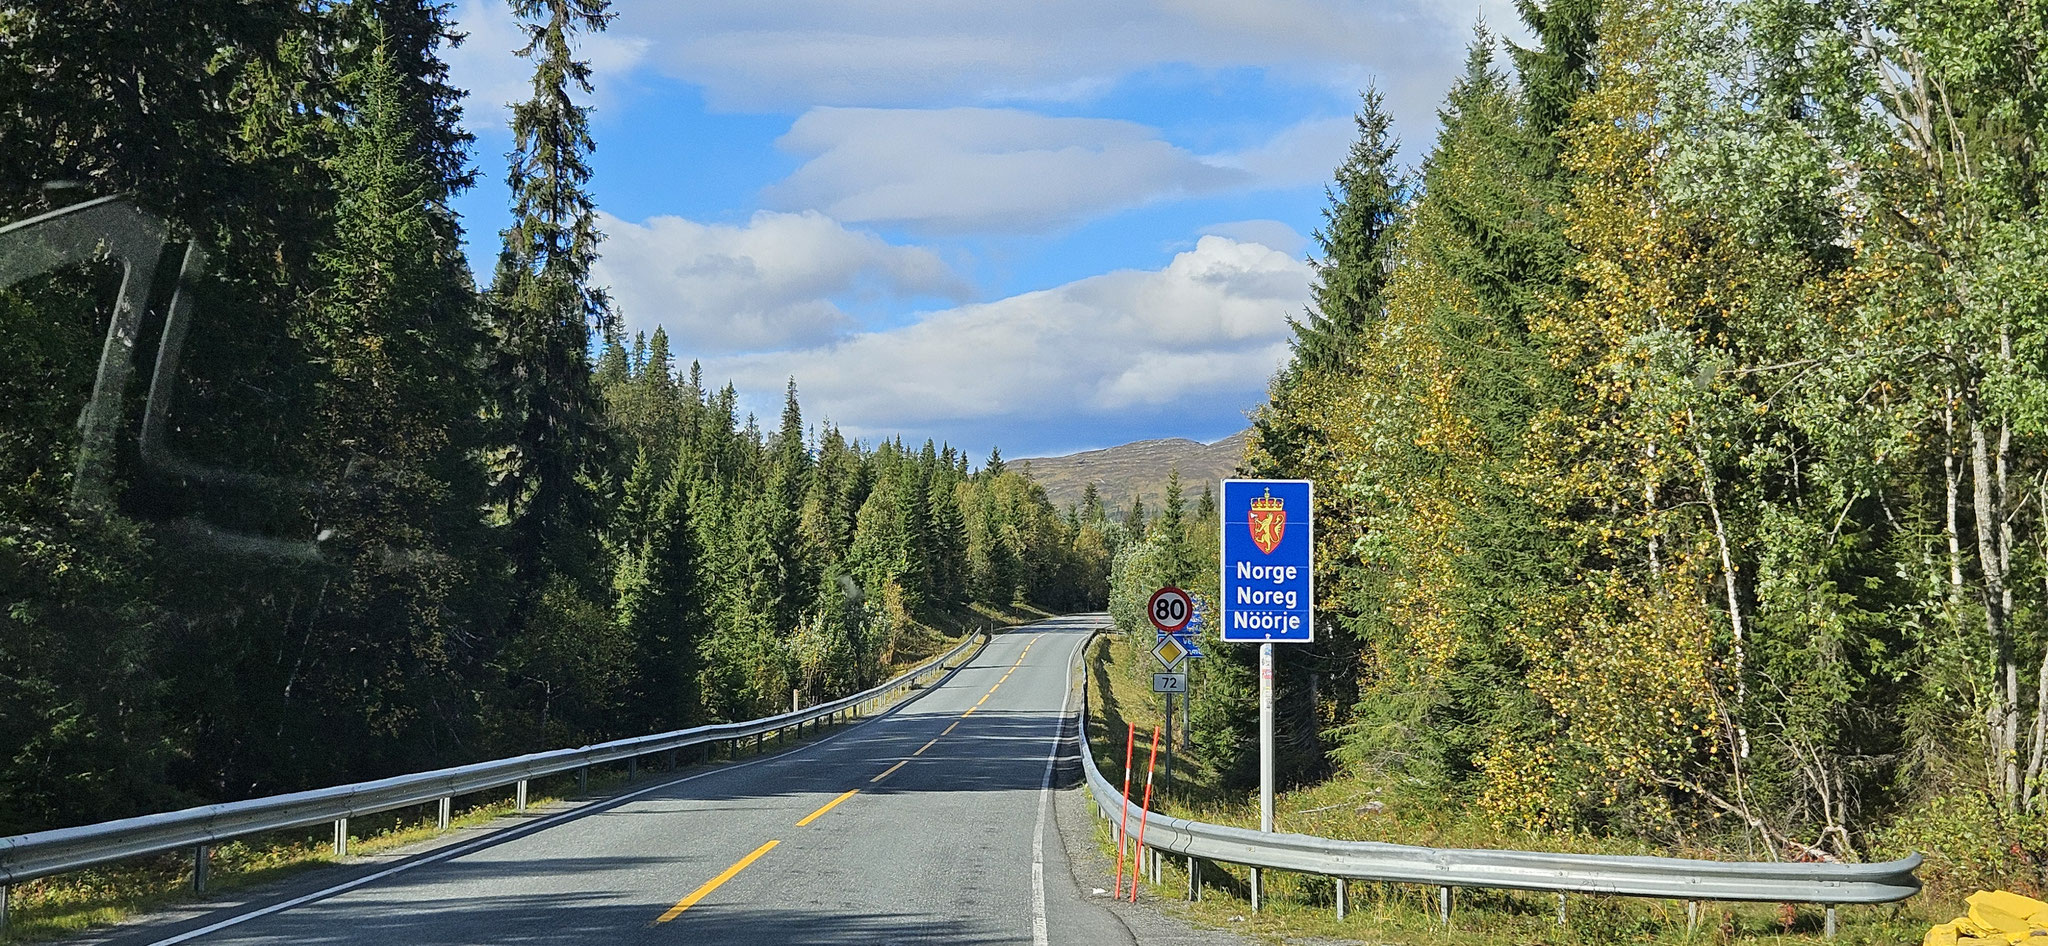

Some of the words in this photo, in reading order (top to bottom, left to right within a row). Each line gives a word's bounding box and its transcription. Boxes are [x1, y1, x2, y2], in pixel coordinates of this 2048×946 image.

[1237, 561, 1297, 584] Norge
[1155, 598, 1185, 620] 80
[1237, 586, 1297, 609] Noreg
[1234, 611, 1300, 634] Nöörje
[1161, 677, 1177, 689] 72
